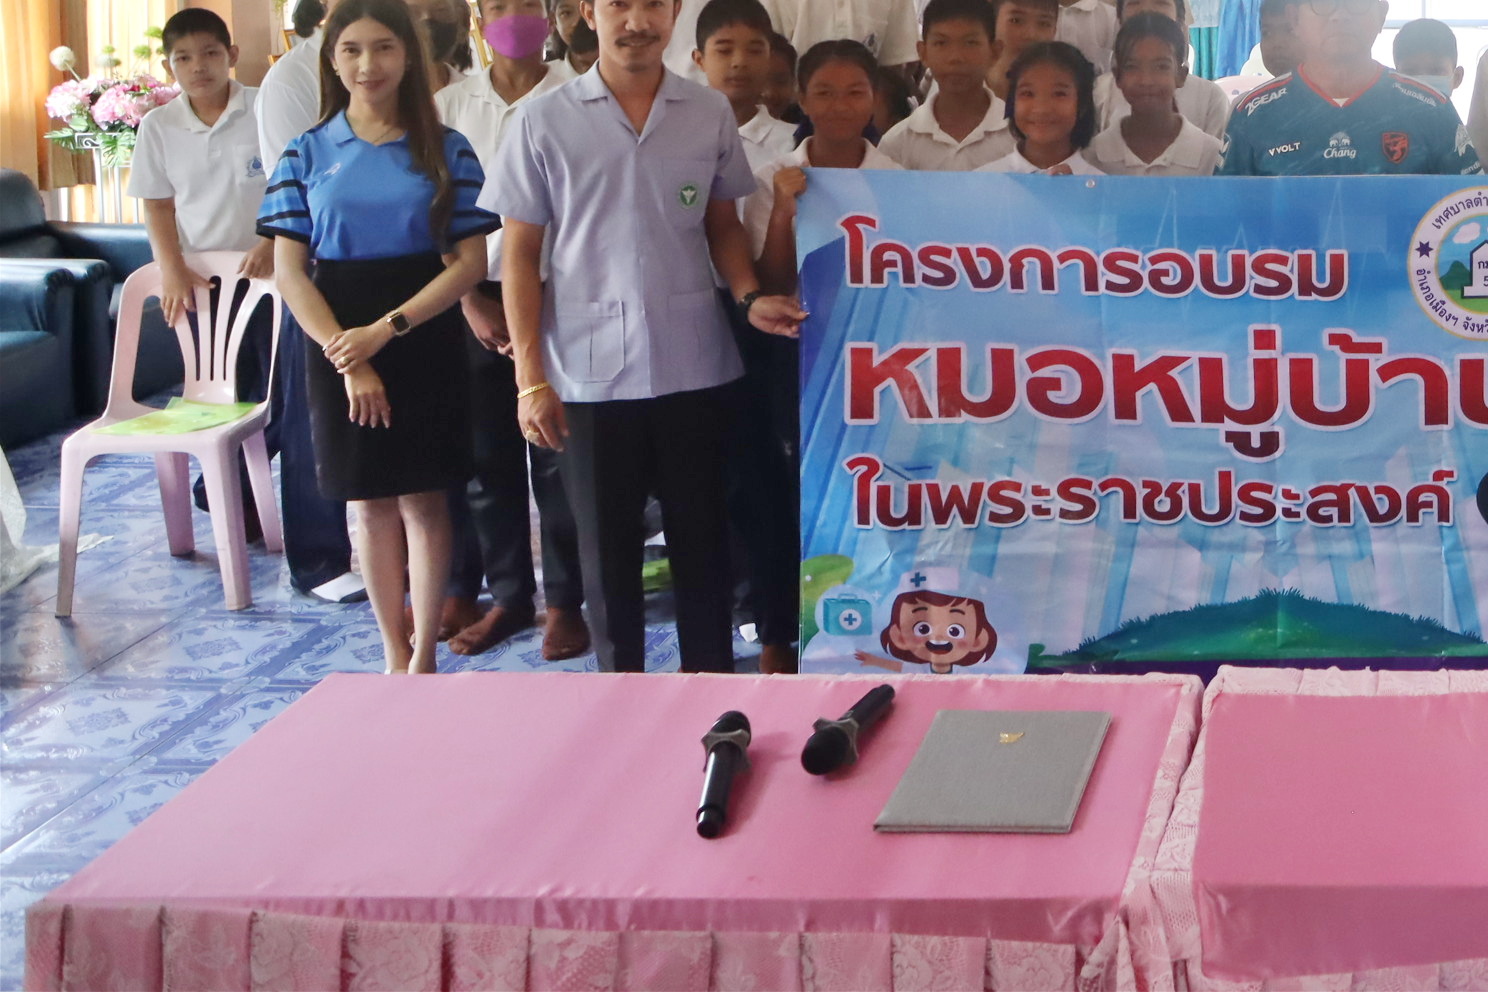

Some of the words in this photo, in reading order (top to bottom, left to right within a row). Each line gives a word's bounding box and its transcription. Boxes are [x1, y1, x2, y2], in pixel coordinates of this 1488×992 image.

[1323, 147, 1357, 159] Chang
[845, 216, 1344, 296] โครงการอบรม
[1416, 268, 1459, 327] อำเภอเมืองฯ
[848, 457, 1454, 525] ในพระราชประสงค์
